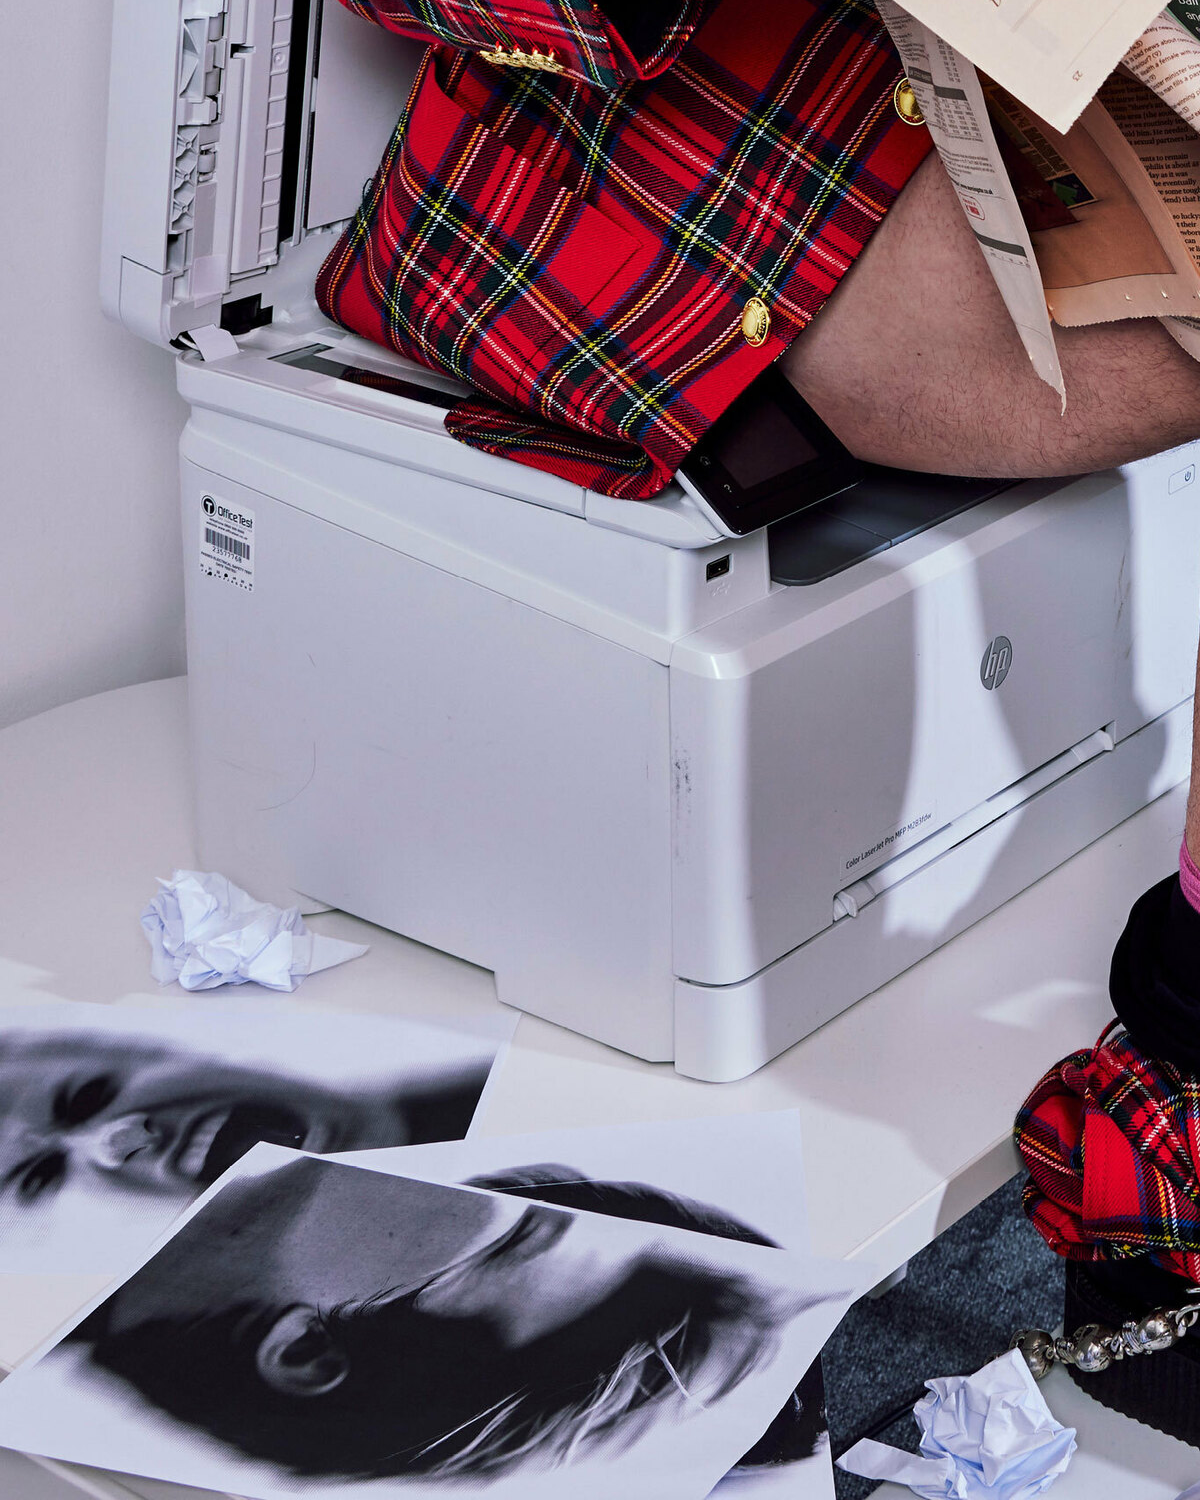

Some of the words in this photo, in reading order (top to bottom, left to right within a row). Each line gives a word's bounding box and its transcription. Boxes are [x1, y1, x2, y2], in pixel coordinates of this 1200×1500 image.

[1072, 69, 1083, 82] 23
[846, 857, 860, 870] Color
[861, 841, 884, 860] LaserJet
[884, 835, 895, 846] Pro
[895, 826, 907, 839] MFP
